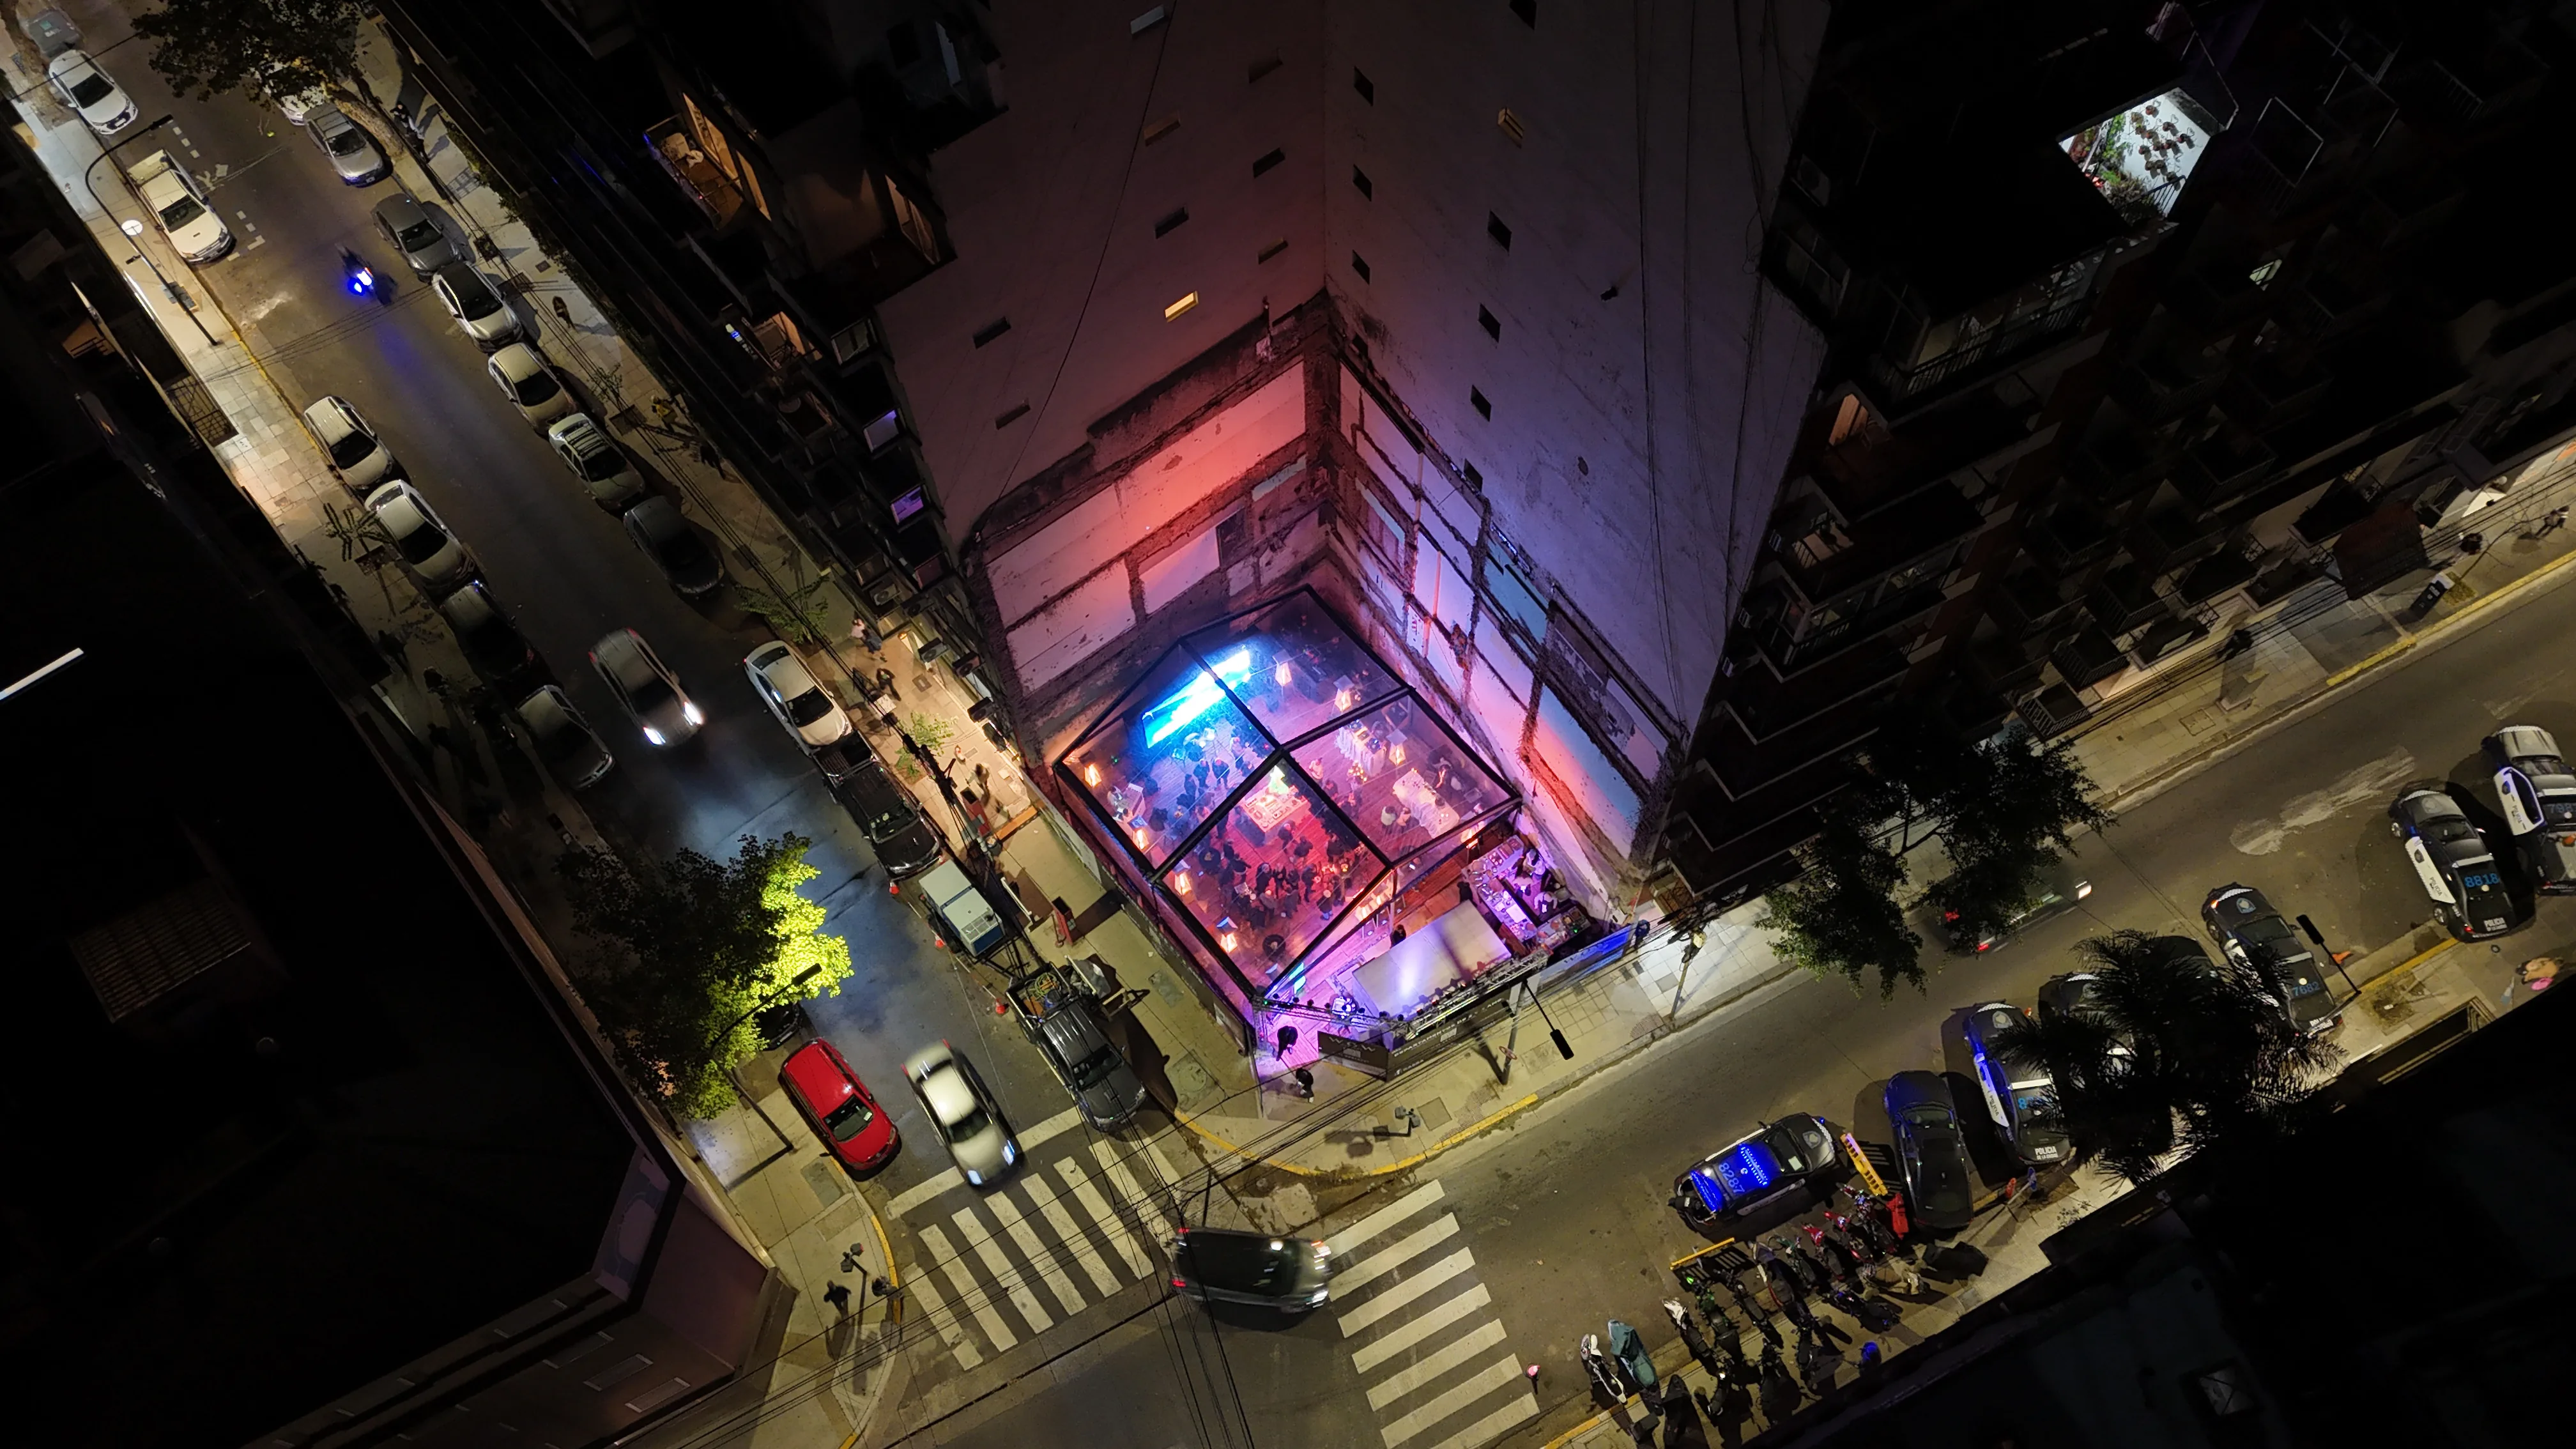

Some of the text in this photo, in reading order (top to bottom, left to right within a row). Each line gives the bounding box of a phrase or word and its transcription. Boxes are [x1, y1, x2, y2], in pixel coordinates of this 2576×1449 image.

[2429, 877, 2442, 896] POLICIA
[2464, 873, 2500, 887] 8818
[2034, 1146, 2057, 1156] POLICIA
[1718, 1162, 1745, 1195] 8287
